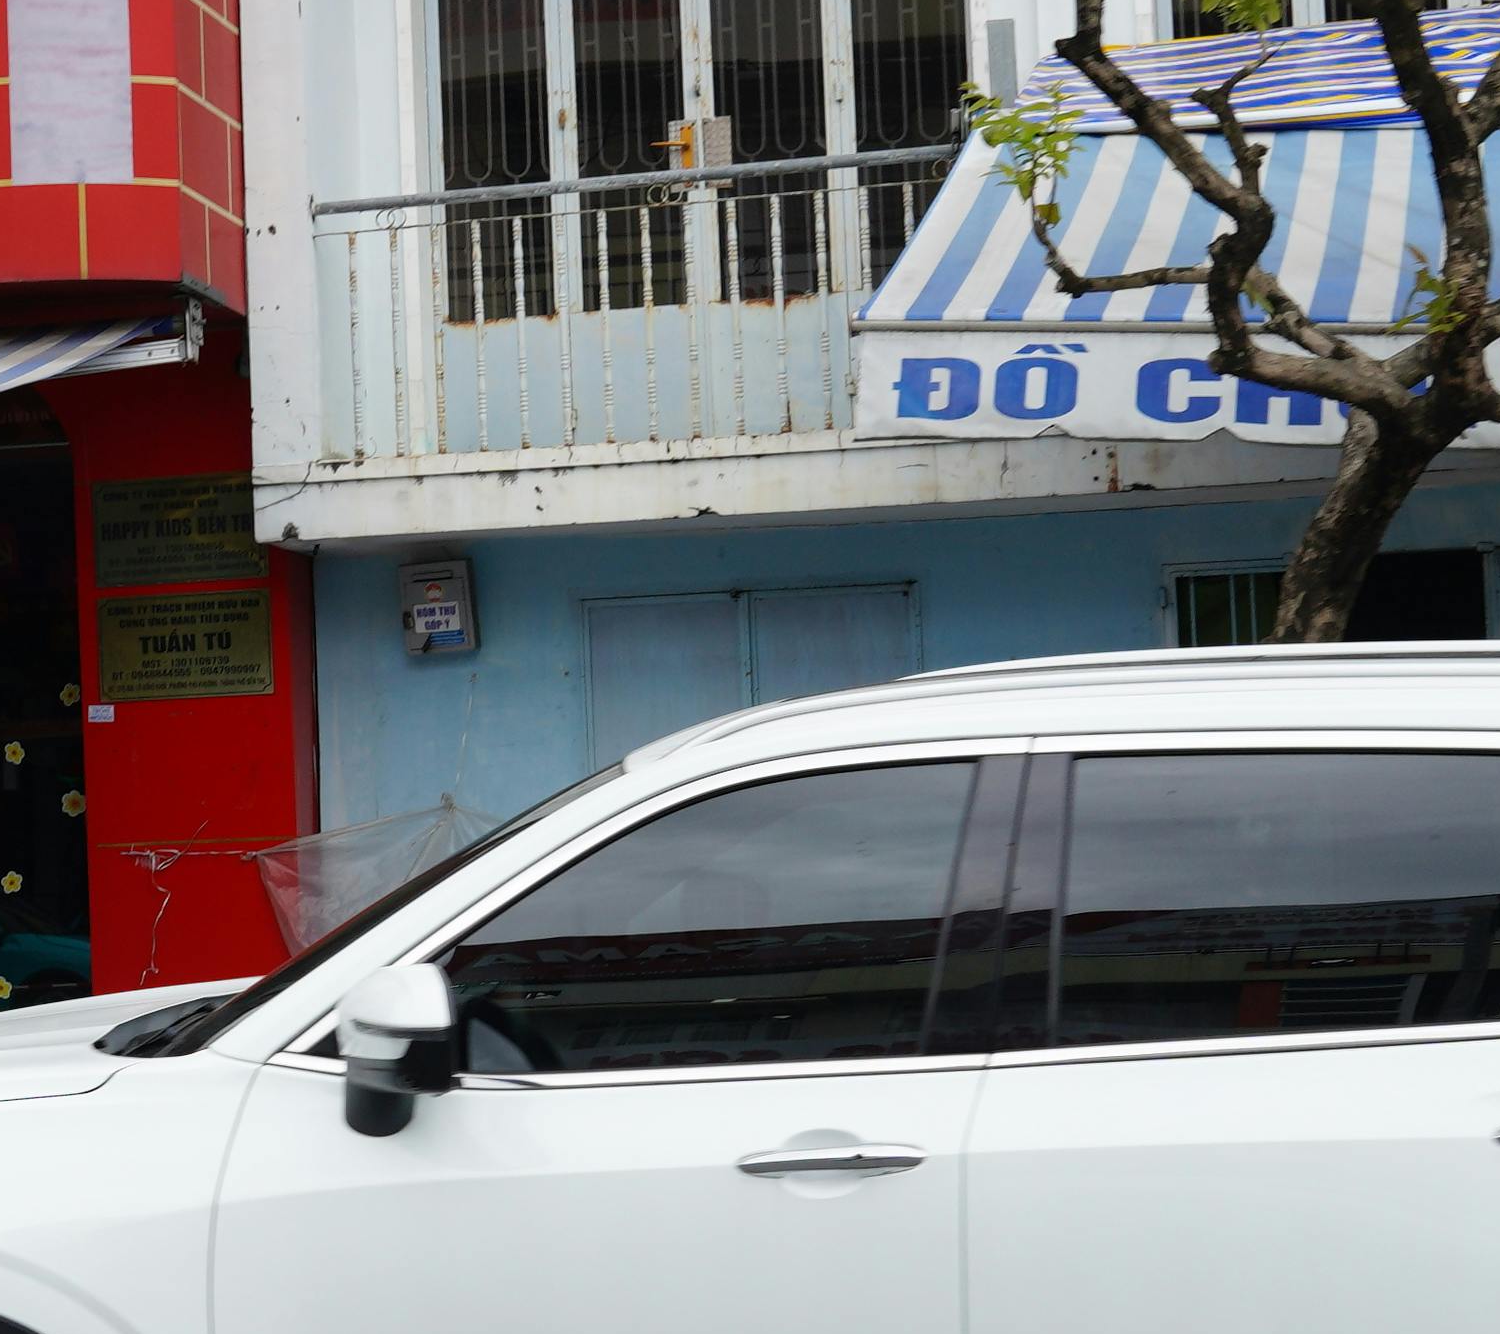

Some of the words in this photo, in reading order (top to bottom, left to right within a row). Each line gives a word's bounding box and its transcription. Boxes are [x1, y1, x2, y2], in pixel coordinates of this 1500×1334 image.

[892, 342, 1089, 420] ĐỒ
[139, 629, 196, 655] TUẤN
[203, 629, 232, 651] TÚ
